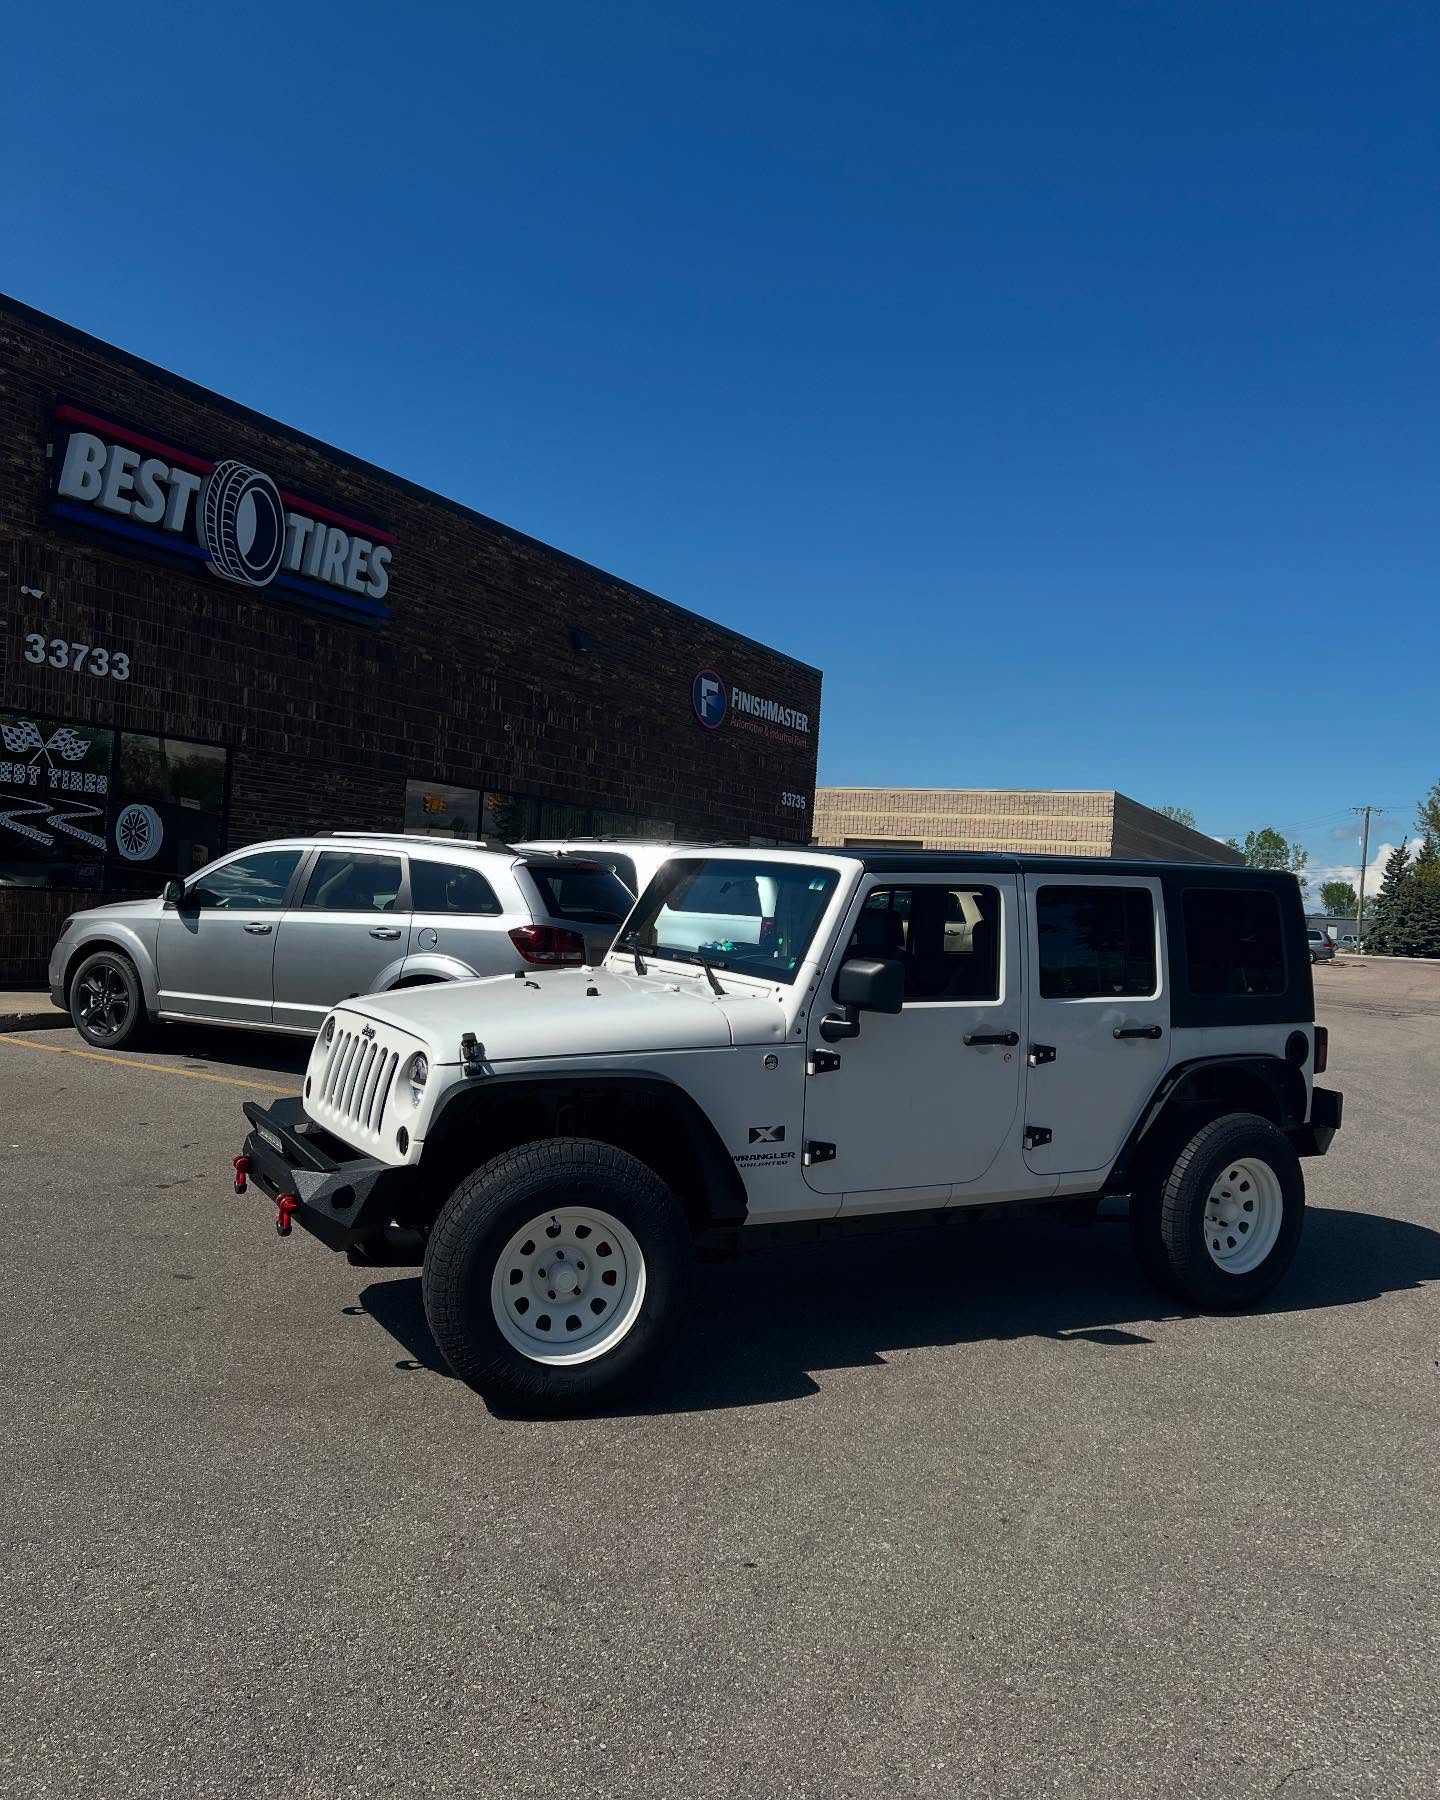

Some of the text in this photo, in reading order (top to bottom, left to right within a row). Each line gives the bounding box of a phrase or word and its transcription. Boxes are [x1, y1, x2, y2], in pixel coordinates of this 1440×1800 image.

[58, 432, 393, 599] BEST TIRES
[24, 633, 130, 681] 33733
[47, 768, 108, 794] TIRES
[781, 791, 806, 810] 33735
[731, 1151, 796, 1162] WRANGLER
[740, 1160, 788, 1168] UNLIMITED
